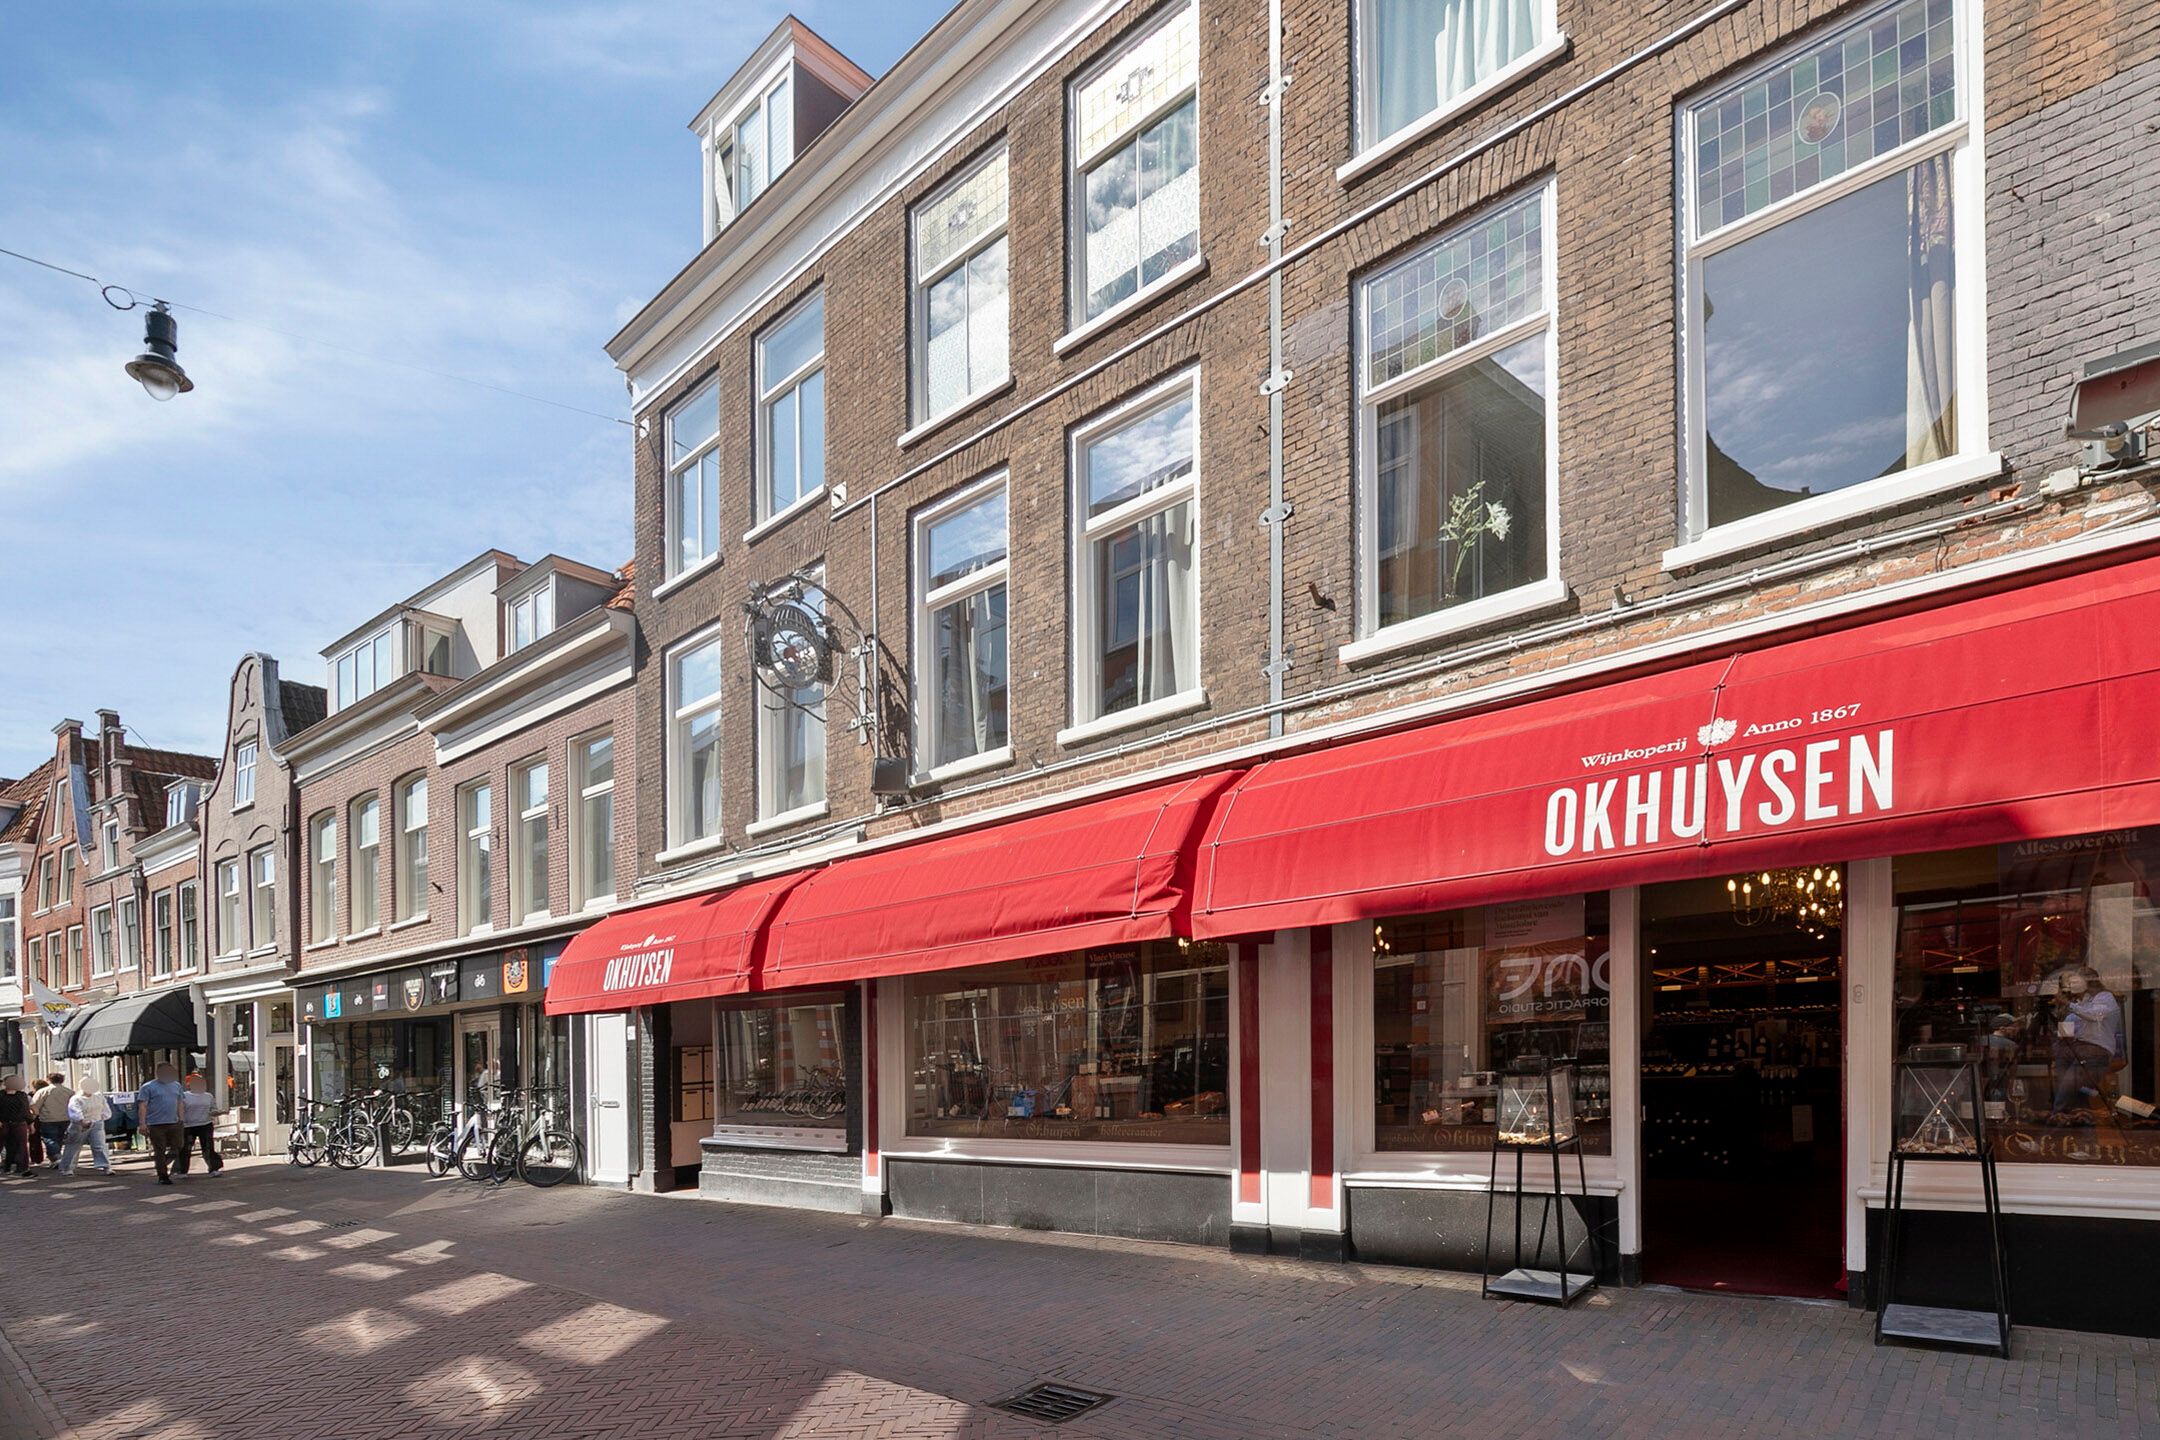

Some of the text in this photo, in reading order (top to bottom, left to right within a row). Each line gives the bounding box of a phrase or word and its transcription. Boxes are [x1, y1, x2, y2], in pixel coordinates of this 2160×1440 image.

[1743, 703, 1861, 738] Anno 1867
[1581, 737, 1688, 768] Wijnkoperij
[1544, 729, 1895, 857] OKHUYSEN
[603, 948, 674, 992] OKHUYSEN
